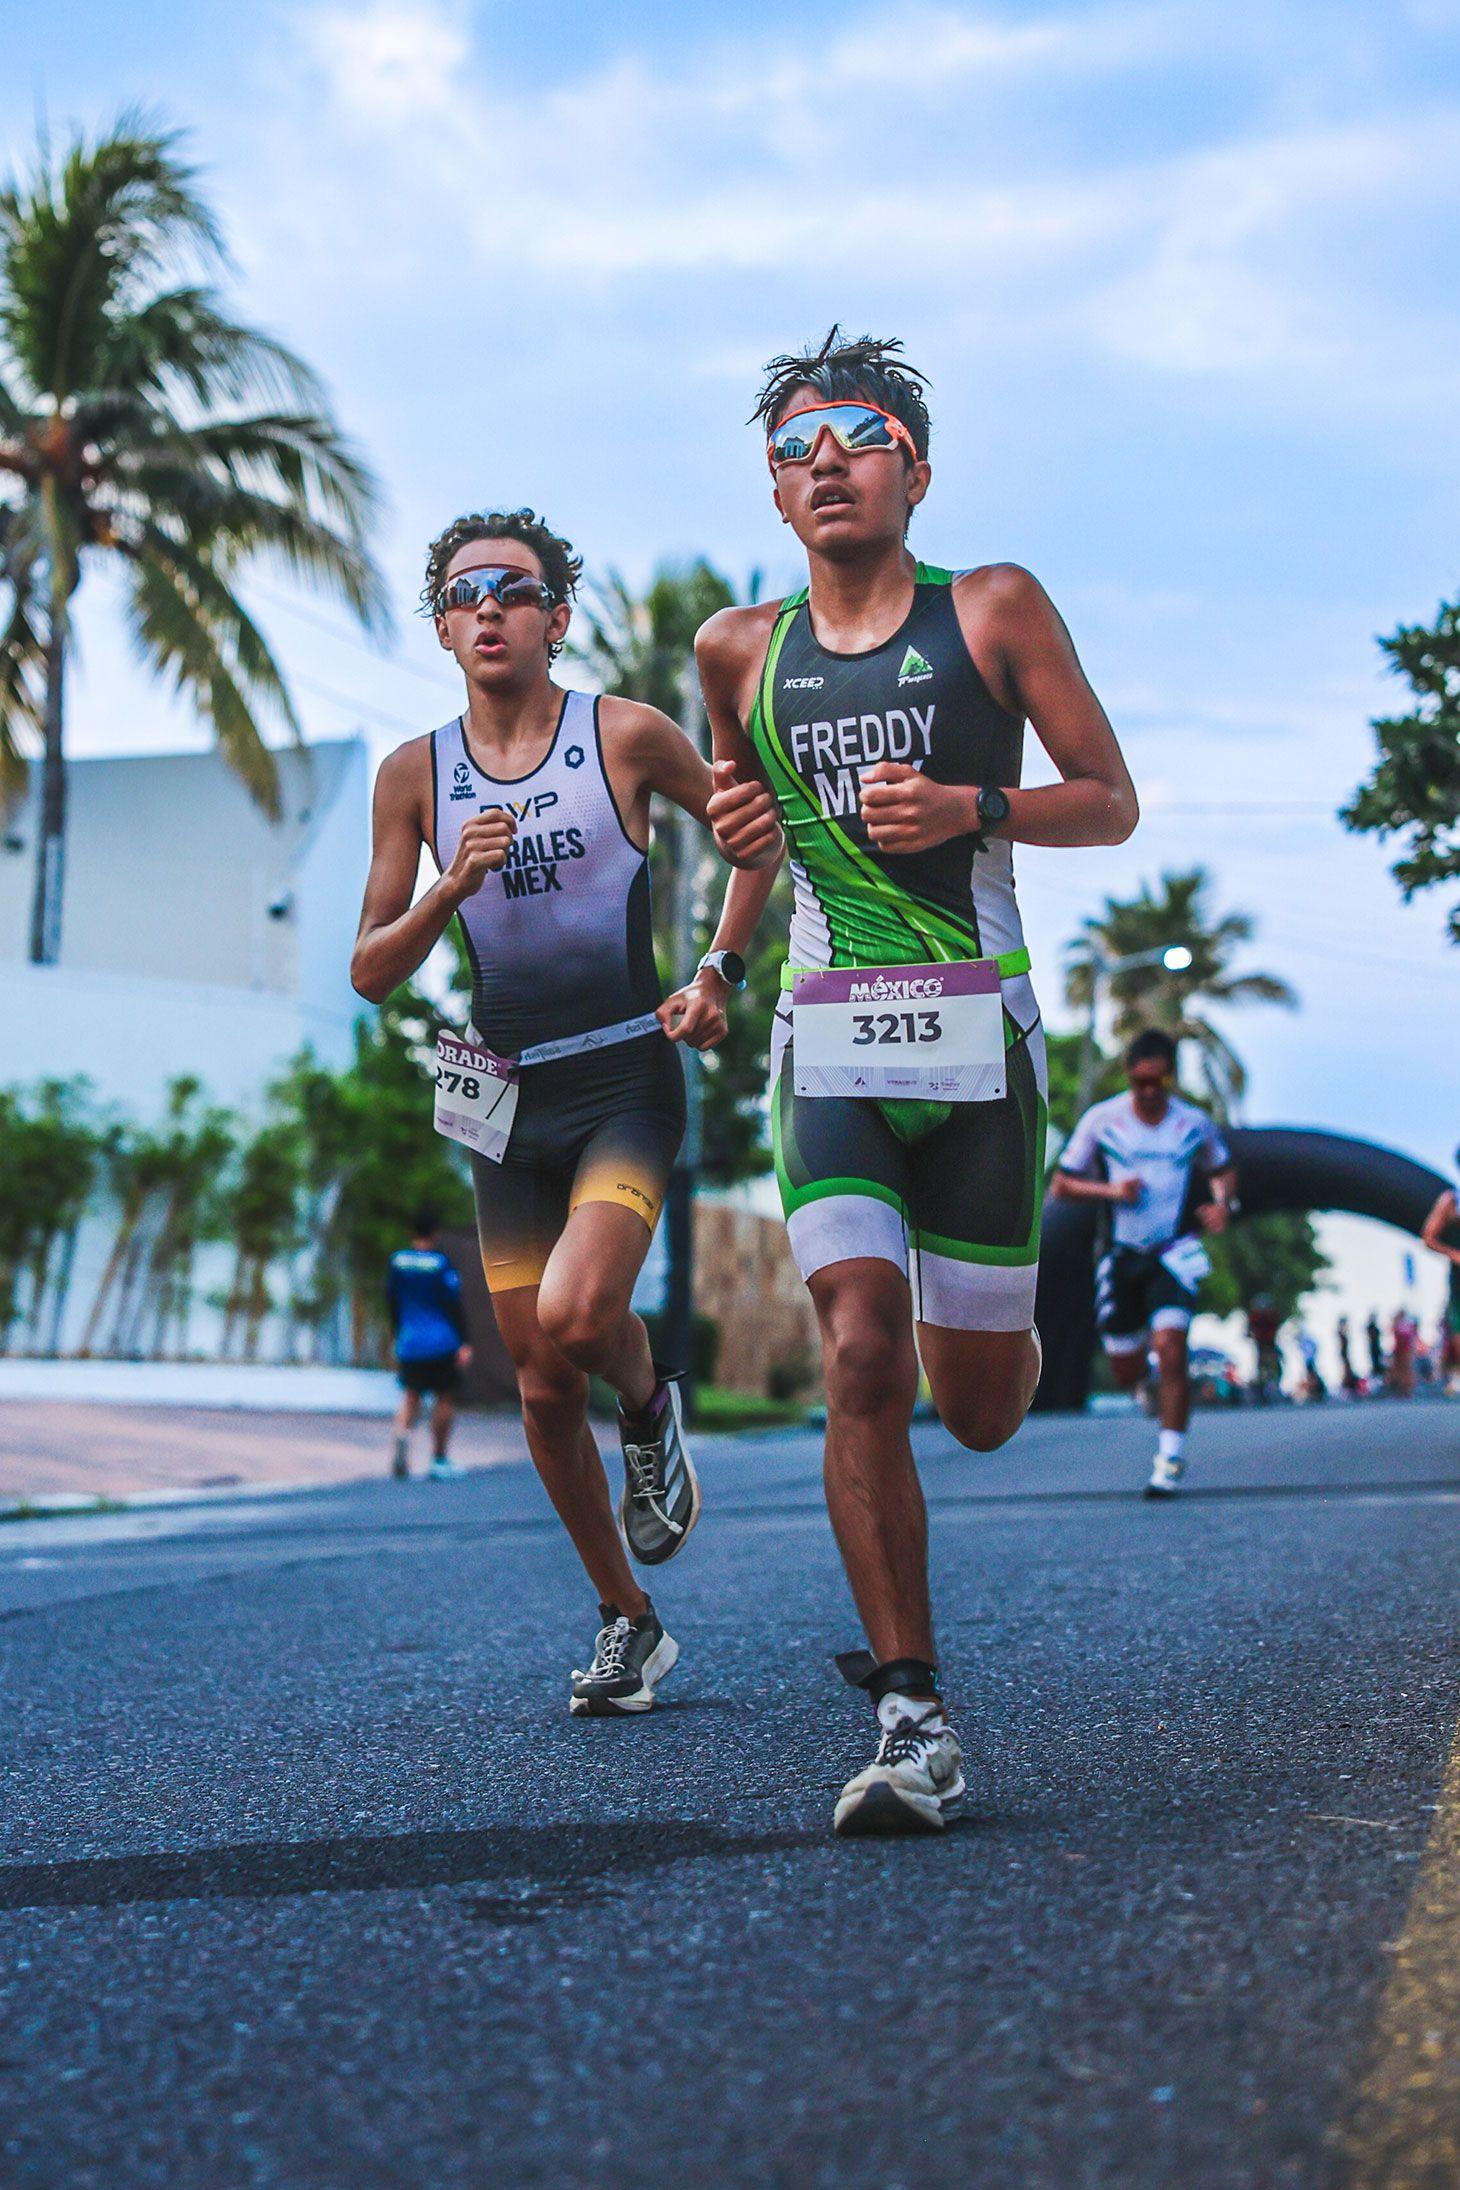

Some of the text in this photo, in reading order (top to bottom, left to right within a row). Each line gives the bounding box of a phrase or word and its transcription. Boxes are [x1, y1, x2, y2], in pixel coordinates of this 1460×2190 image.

[790, 704, 936, 774] FREDDY
[486, 828, 586, 873] RALES
[501, 863, 563, 900] MEX
[852, 1010, 943, 1045] 3213
